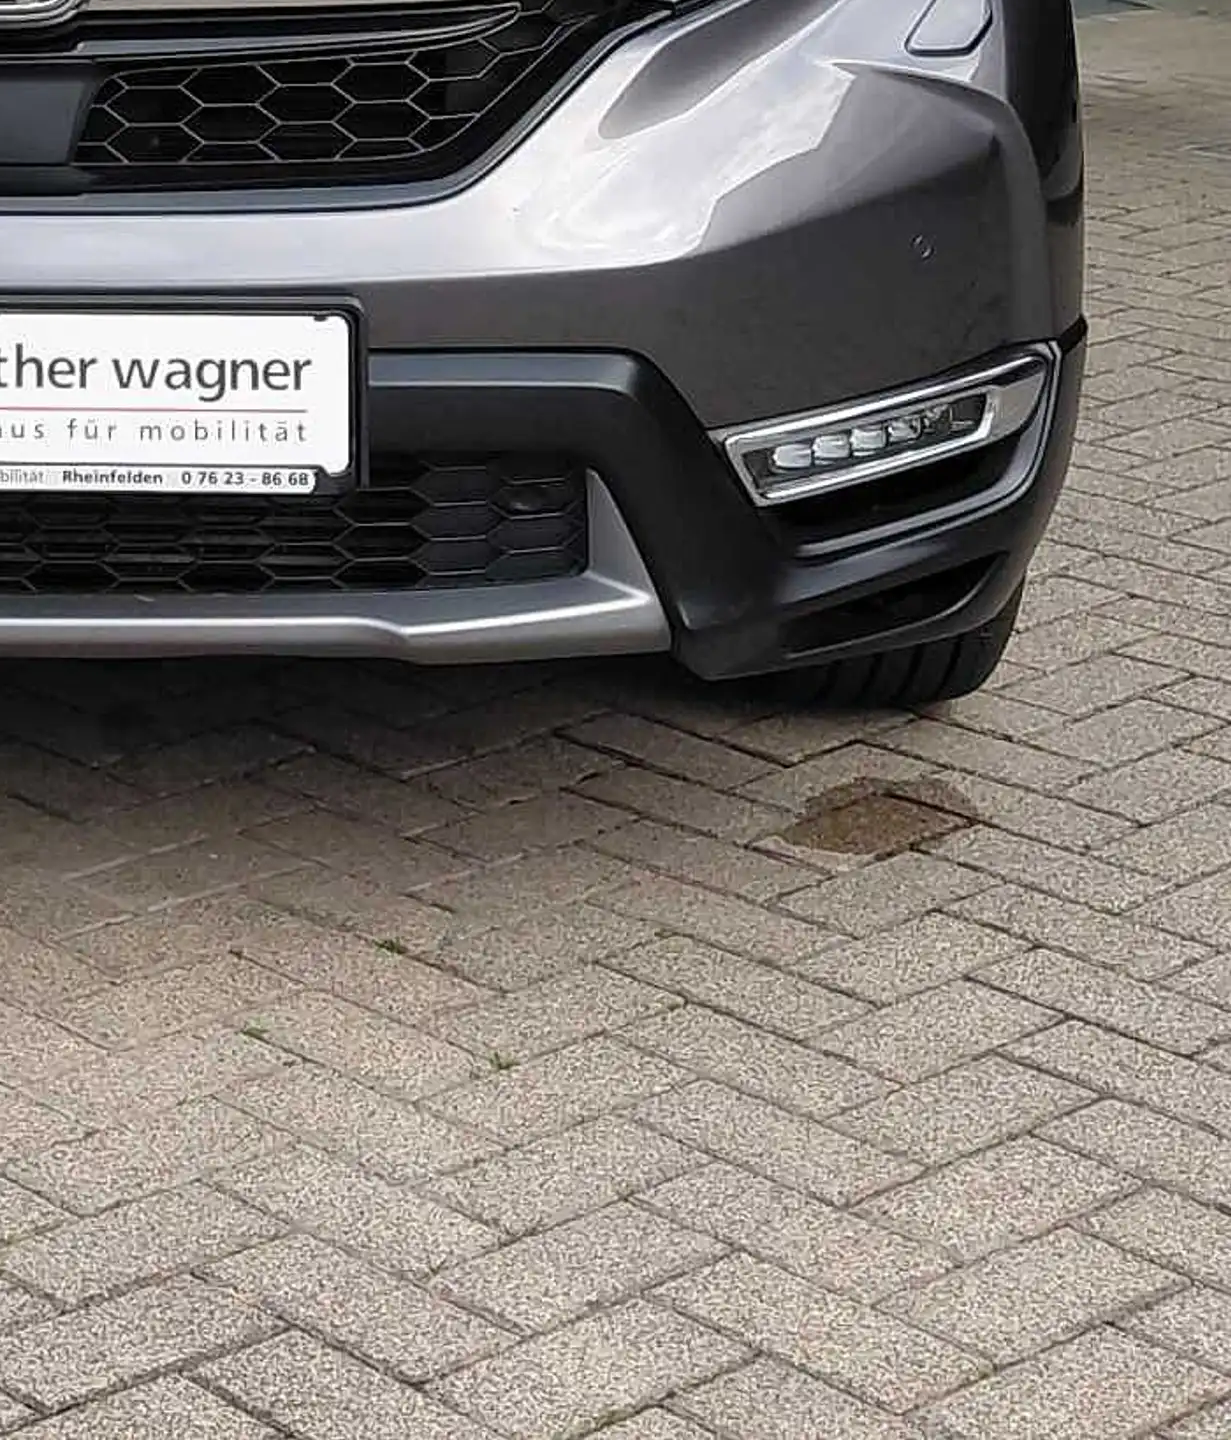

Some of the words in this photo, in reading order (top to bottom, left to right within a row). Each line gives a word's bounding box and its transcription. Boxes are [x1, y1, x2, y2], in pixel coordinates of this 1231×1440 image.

[111, 358, 312, 403] wagner
[67, 417, 117, 441] für
[139, 419, 307, 442] mobilität
[62, 469, 163, 485] Rheinfelden
